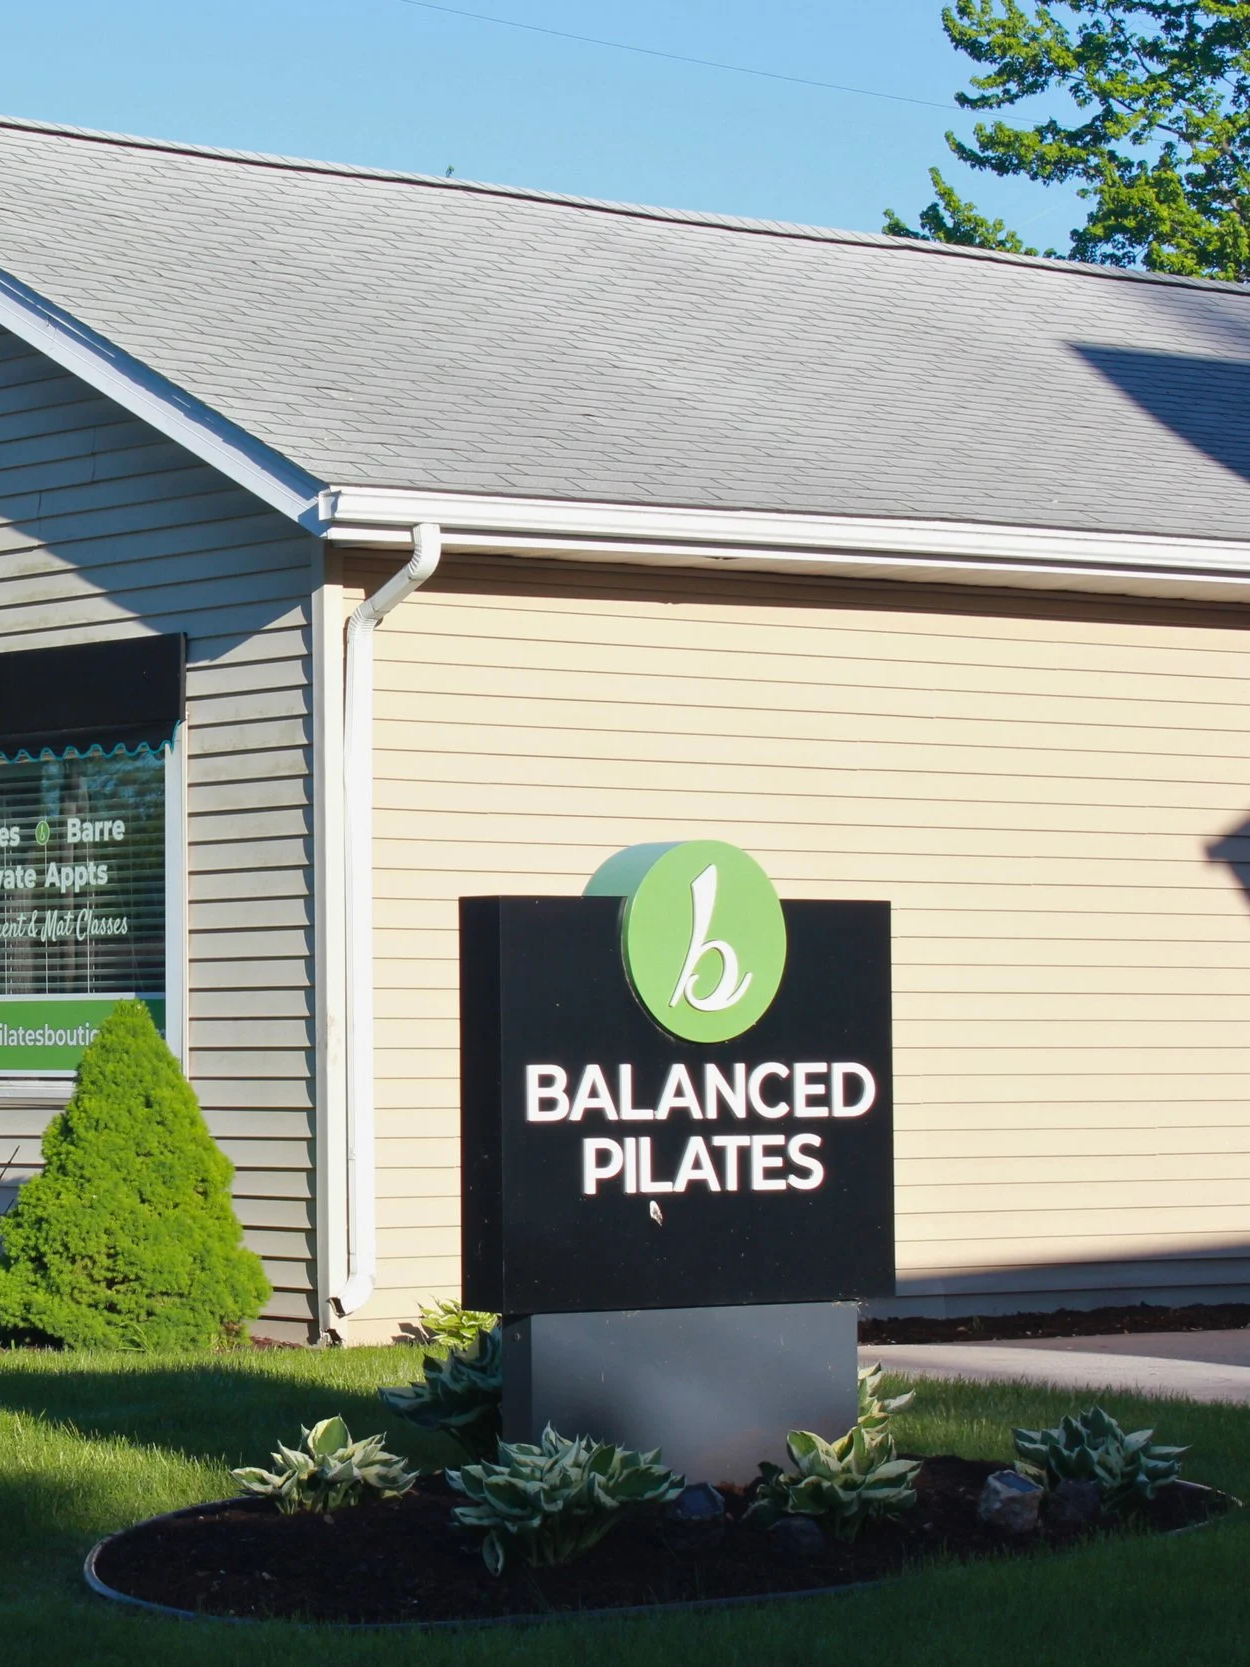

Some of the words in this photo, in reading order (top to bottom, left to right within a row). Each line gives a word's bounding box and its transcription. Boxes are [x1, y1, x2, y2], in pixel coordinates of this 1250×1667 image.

[66, 817, 126, 843] Barre
[44, 861, 109, 894] Appts
[27, 909, 39, 937] &
[40, 908, 75, 943] Mat
[76, 908, 128, 941] Classes
[525, 1061, 877, 1122] BALANCED
[582, 1132, 825, 1195] PILATES
